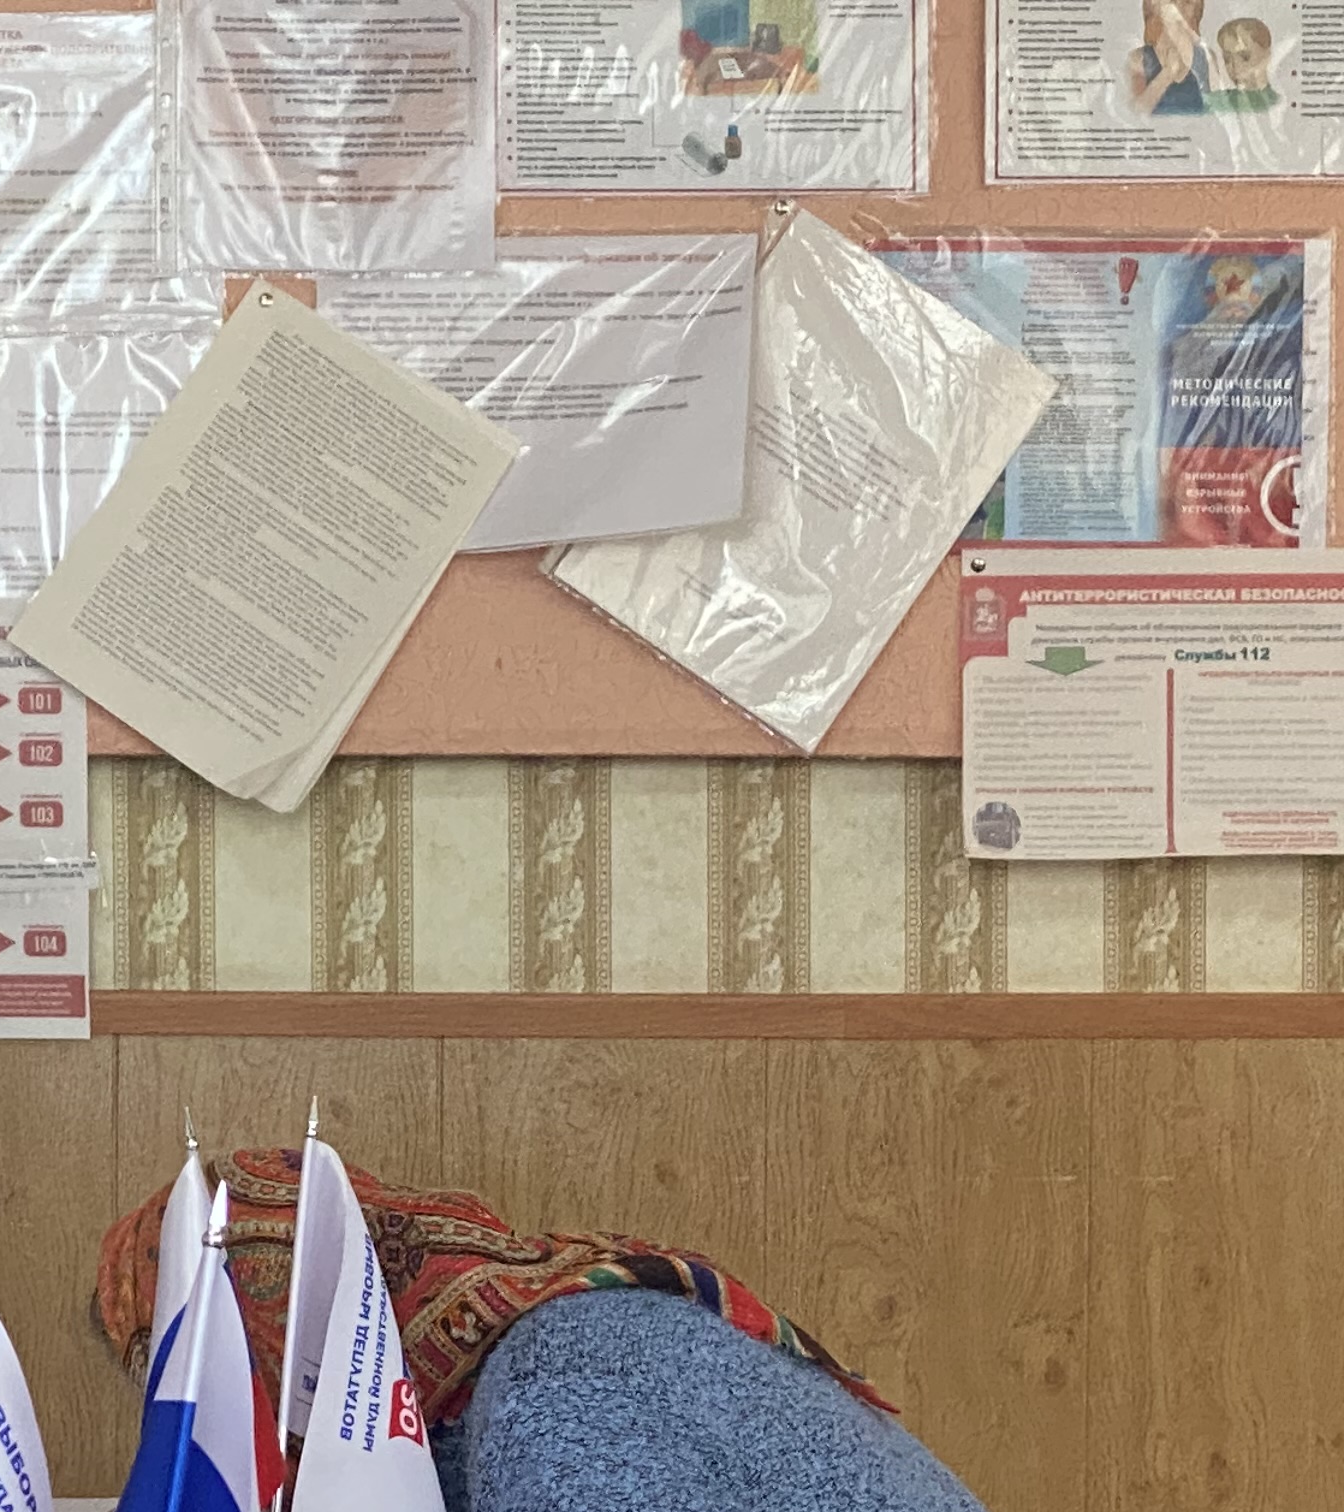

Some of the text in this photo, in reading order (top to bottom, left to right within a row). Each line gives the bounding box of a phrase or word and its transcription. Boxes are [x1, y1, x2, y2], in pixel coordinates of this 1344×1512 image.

[1172, 377, 1293, 392] МЕТОДИЧЕСКИЕ
[1171, 394, 1294, 409] РЕКОМЕНДАЦИИ
[1181, 504, 1252, 515] УСТРОЙСТВА
[1019, 588, 1236, 603] АНТИТЕРРОРИСТИЧЕСКАЯ
[1174, 648, 1237, 663] Службы
[1240, 646, 1271, 661] 112
[29, 693, 52, 710] 101
[30, 745, 54, 762] 102
[31, 806, 55, 824] 103
[34, 935, 58, 953] 104
